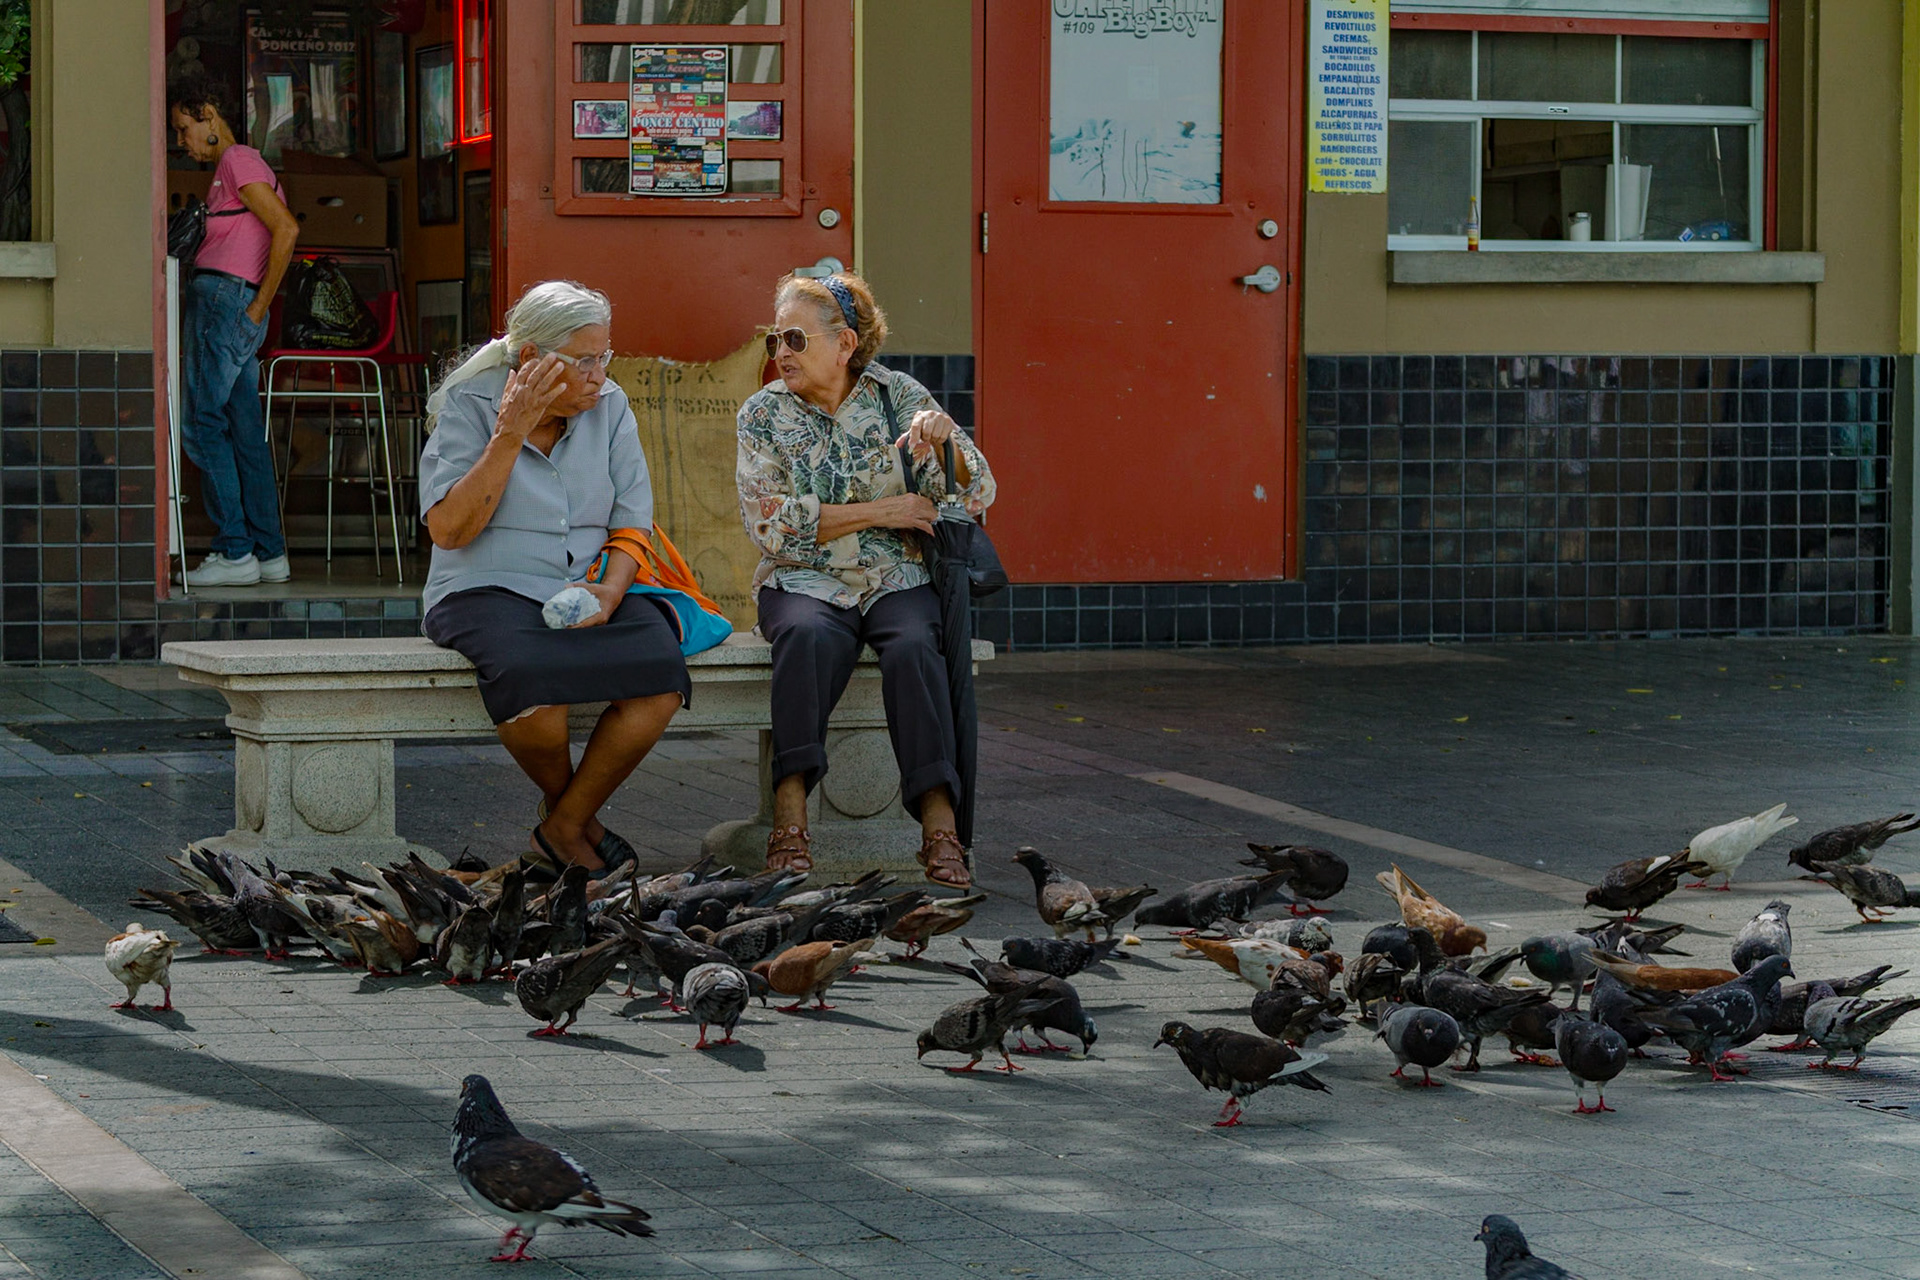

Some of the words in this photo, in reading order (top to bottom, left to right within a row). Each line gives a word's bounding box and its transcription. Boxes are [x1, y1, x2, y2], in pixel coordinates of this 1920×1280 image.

[1326, 10, 1375, 20] DESAYUNOS
[1063, 22, 1095, 34] #109
[1102, 8, 1150, 39] Big
[1150, 7, 1204, 38] Boy
[1324, 22, 1377, 32] REVOLTILLOS
[1333, 34, 1369, 43] CREMAS
[260, 39, 325, 52] PONCEÑO
[327, 42, 356, 52] 2012
[1322, 45, 1378, 55] SANDWICHES
[1324, 62, 1376, 72] BOCADILLOS
[1319, 74, 1381, 84] EMPANADILLAS
[1324, 86, 1376, 96] BACALAITOS
[1326, 98, 1374, 107] DOMPLINES
[1321, 109, 1379, 119] ALCAPURRIAS
[632, 117, 673, 128] PONCE
[675, 117, 725, 128] CENTRO
[1353, 122, 1363, 131] DE
[1364, 122, 1383, 131] PAPA
[1321, 133, 1377, 142] SORRULLITOS
[1320, 145, 1378, 154] HAMBURGERS
[1339, 157, 1382, 166] CHOCOLATE
[1354, 169, 1377, 177] AGUA
[1325, 180, 1372, 189] REFRESCOS
